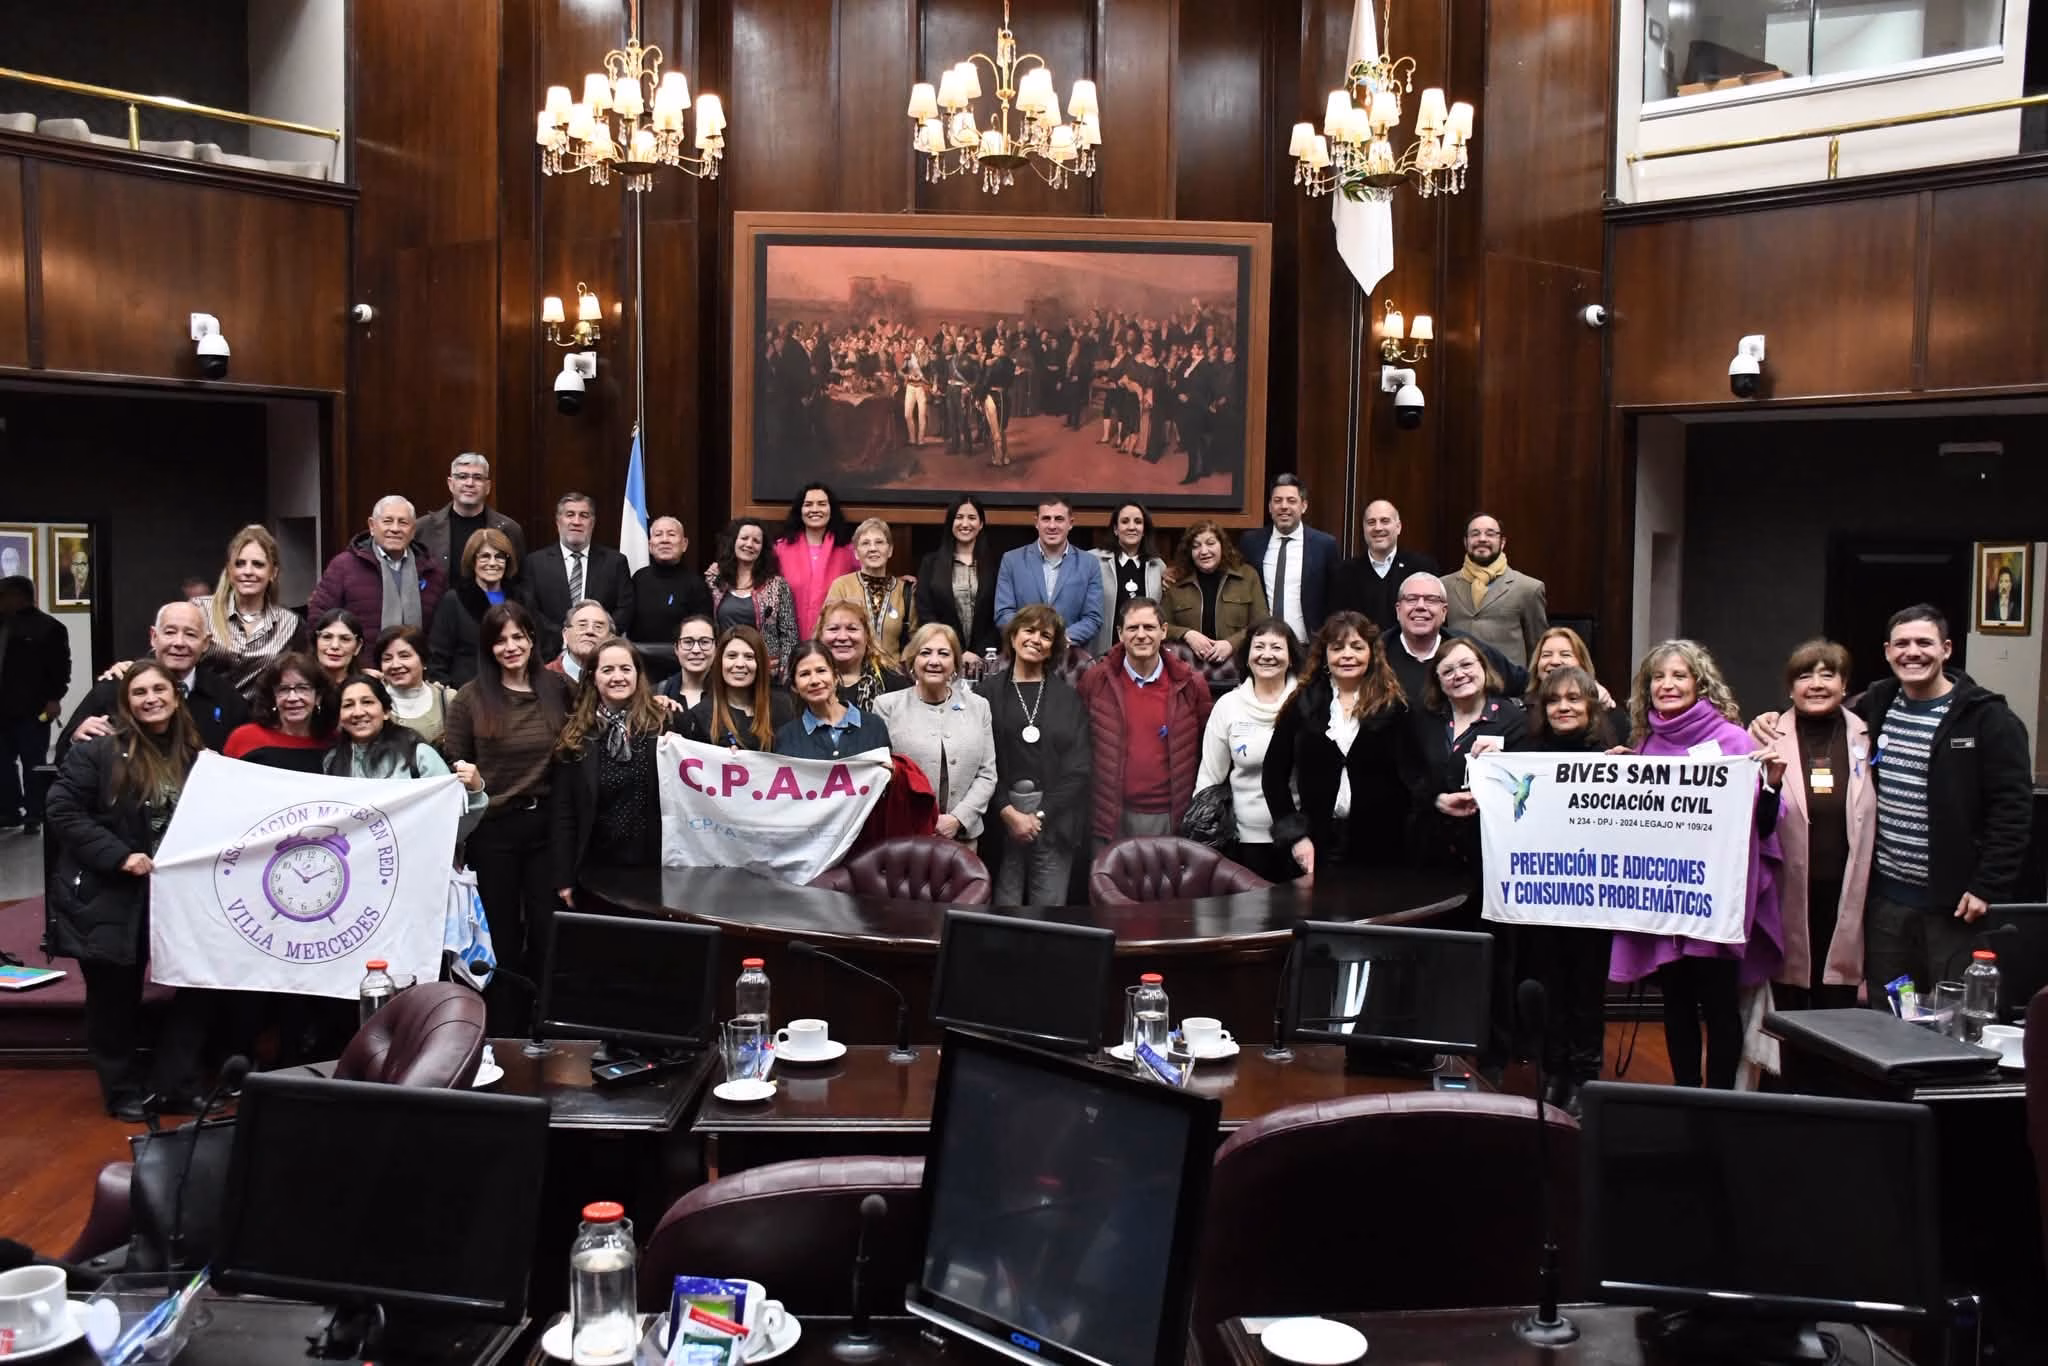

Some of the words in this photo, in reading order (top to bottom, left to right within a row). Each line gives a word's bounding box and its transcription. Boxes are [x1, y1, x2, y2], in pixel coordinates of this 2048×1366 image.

[678, 758, 870, 800] C.P.A.A.
[1556, 763, 1618, 783] BIVES
[1627, 764, 1670, 784] SAN
[1680, 764, 1728, 787] LUIS
[1568, 790, 1664, 811] ASOCIACIÓN
[1671, 796, 1712, 814] CIVIL
[223, 808, 309, 866] ASACIÓN
[369, 819, 389, 841] EN
[1569, 817, 1575, 825] N
[1577, 817, 1591, 825] 234
[1597, 818, 1613, 826] DPJ
[1620, 819, 1638, 827] 2024
[1640, 819, 1673, 829] LEGAJO
[1687, 822, 1713, 831] 109/24
[378, 845, 394, 877] RED
[1510, 848, 1597, 876] PREVENCIÓN
[1601, 854, 1619, 877] DE
[1623, 855, 1706, 885] ADICCIONES
[1501, 881, 1510, 904] Y
[1515, 881, 1595, 906] CONSUMOS
[1598, 884, 1712, 918] PROBLEMÁTICOS
[227, 898, 274, 950] VILLA
[284, 906, 381, 960] MERCEDES
